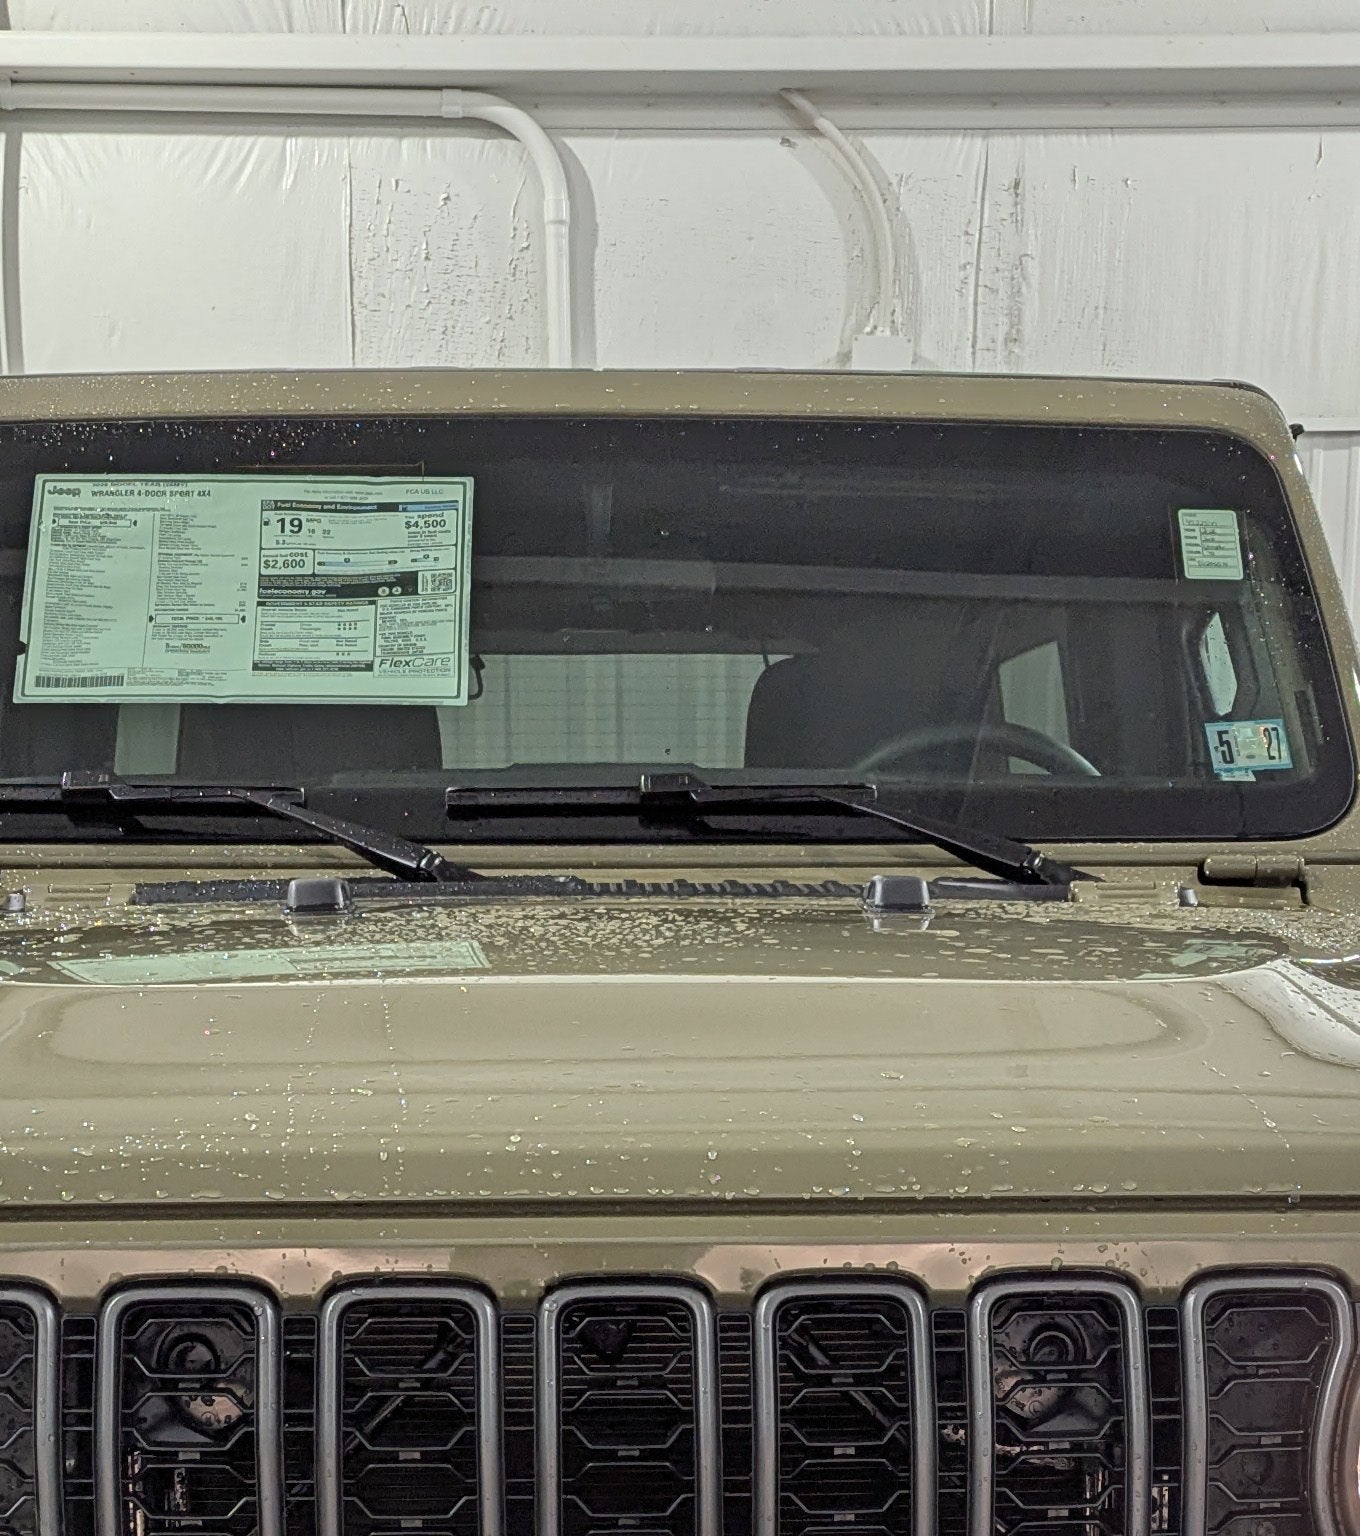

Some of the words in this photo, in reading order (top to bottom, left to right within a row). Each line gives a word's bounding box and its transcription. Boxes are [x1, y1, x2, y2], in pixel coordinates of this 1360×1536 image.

[47, 486, 81, 497] Jeep
[417, 512, 444, 520] spend
[276, 517, 303, 534] 19
[405, 519, 447, 530] $4,500
[263, 558, 306, 570] $2,600
[379, 656, 451, 668] FlexCare
[1216, 730, 1234, 764] 5
[1263, 727, 1281, 762] 27
